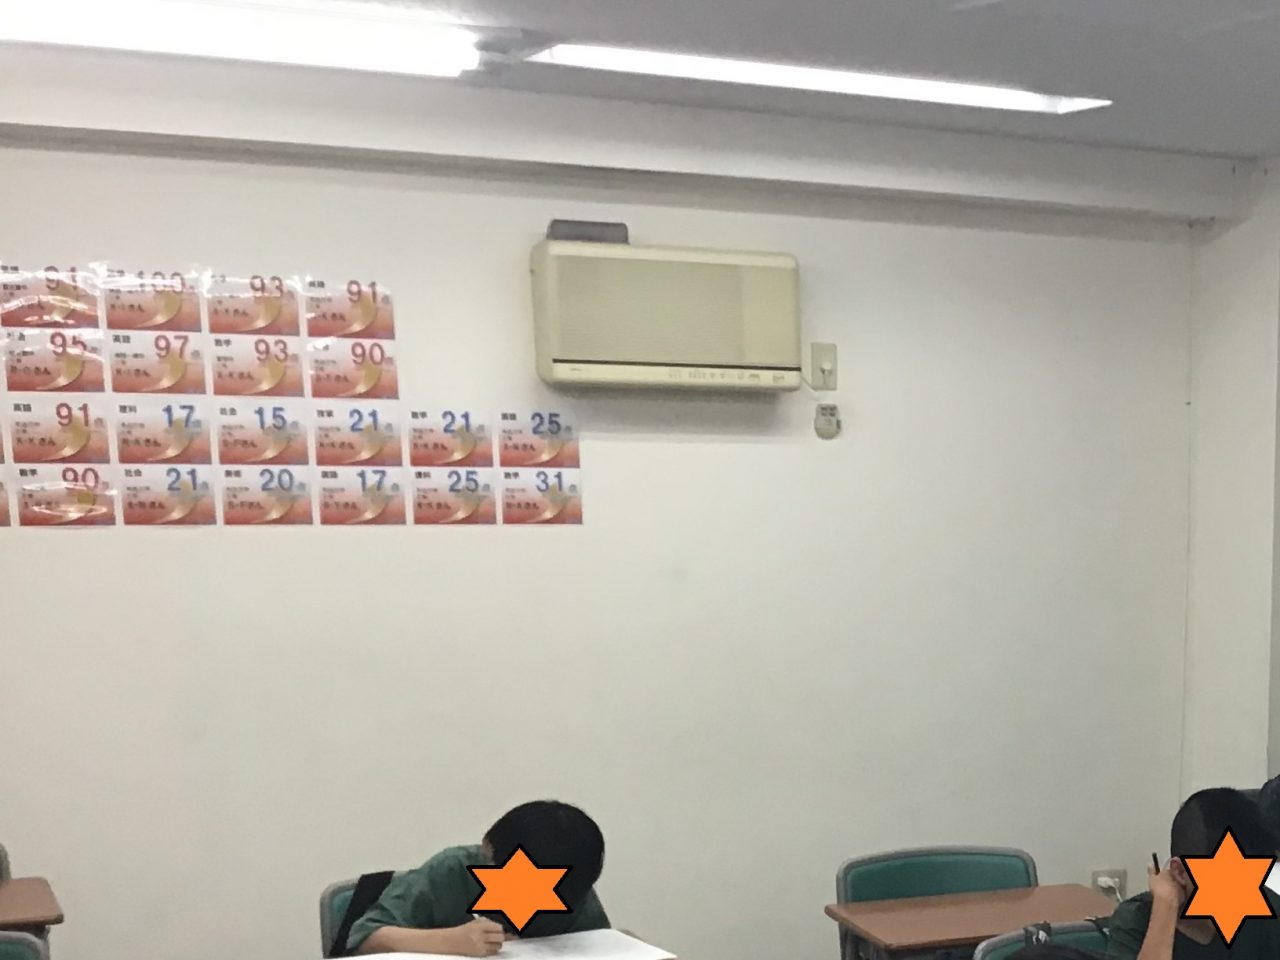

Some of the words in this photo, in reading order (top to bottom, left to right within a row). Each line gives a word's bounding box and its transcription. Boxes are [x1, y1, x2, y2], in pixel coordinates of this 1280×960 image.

[347, 280, 377, 303] 91
[154, 335, 189, 359] 97
[254, 339, 288, 362] 93
[351, 342, 384, 365] 90
[56, 403, 89, 427] 91
[162, 405, 195, 428] 17
[254, 407, 287, 429] 15
[349, 409, 378, 431] 21
[442, 411, 470, 433] 21
[531, 412, 561, 435] 25
[166, 468, 198, 491] 21
[259, 469, 294, 491] 20
[357, 470, 386, 491] 17
[448, 470, 478, 493] 25
[536, 471, 563, 492] 31
